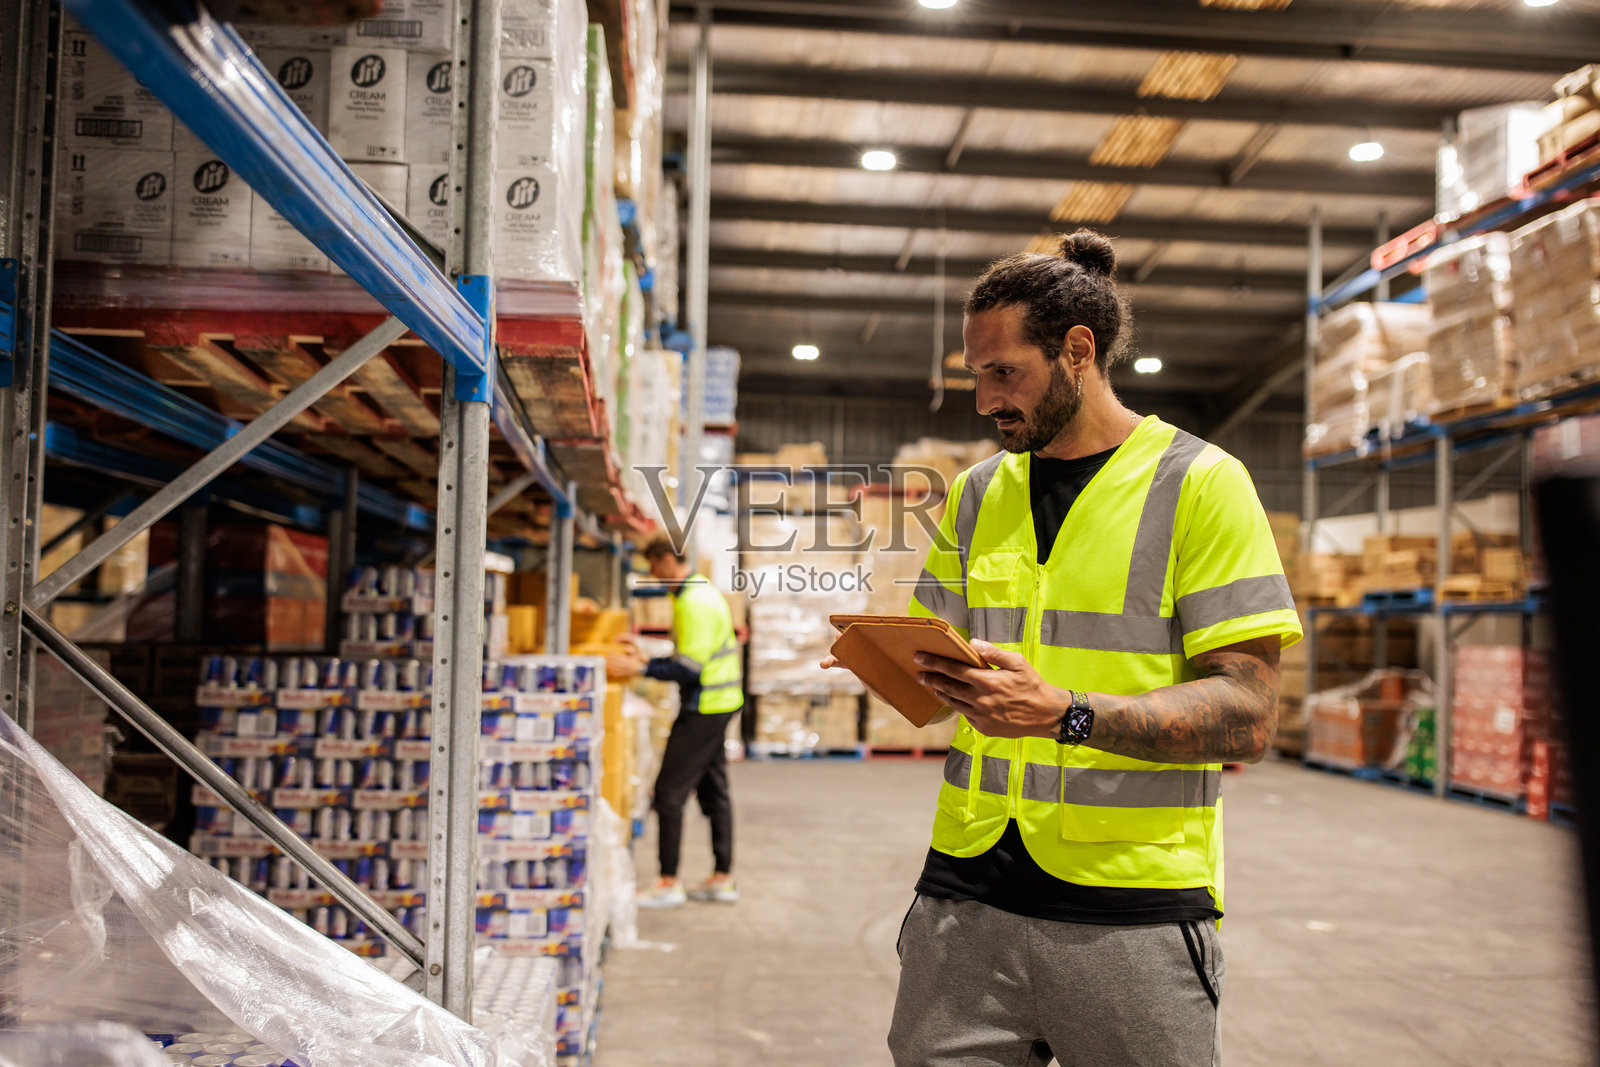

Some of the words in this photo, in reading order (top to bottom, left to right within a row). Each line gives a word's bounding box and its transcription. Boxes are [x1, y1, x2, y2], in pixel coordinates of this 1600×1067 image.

[349, 90, 386, 101] CREAM
[425, 96, 453, 106] CREA
[502, 100, 538, 111] CREAM
[192, 196, 229, 207] CREAM
[505, 212, 541, 222] CREAM
